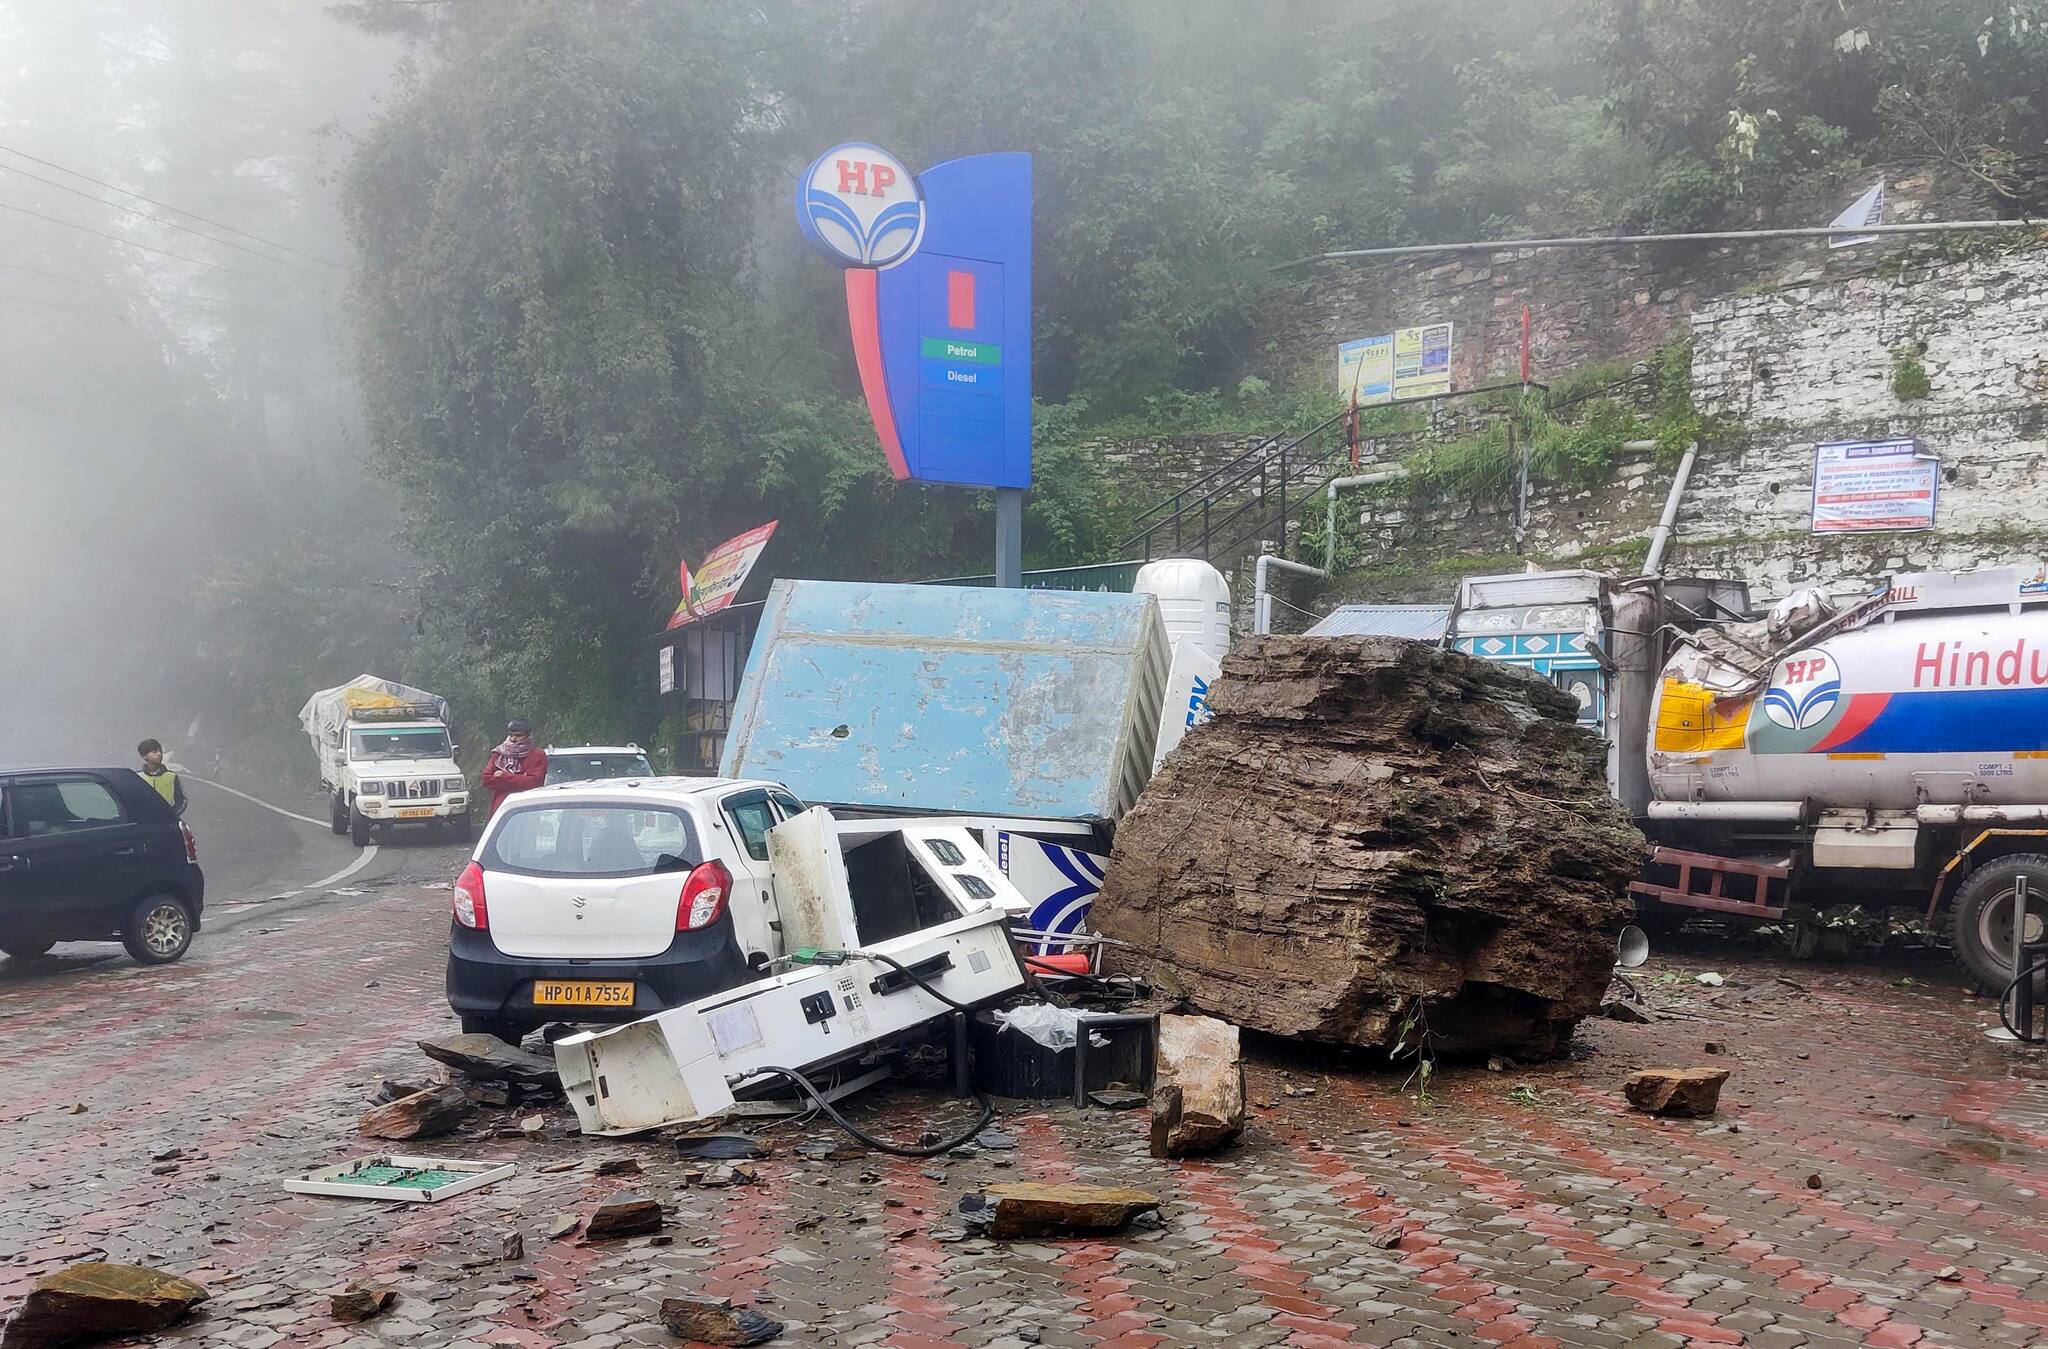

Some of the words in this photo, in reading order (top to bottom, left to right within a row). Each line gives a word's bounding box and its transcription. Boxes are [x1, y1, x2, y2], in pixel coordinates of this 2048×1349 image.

[836, 159, 897, 198] HP
[947, 344, 977, 357] Petrol
[947, 370, 977, 383] Diesel
[1785, 657, 1826, 686] HP
[1913, 638, 2048, 688] Hindu
[1000, 838, 1008, 875] iesel
